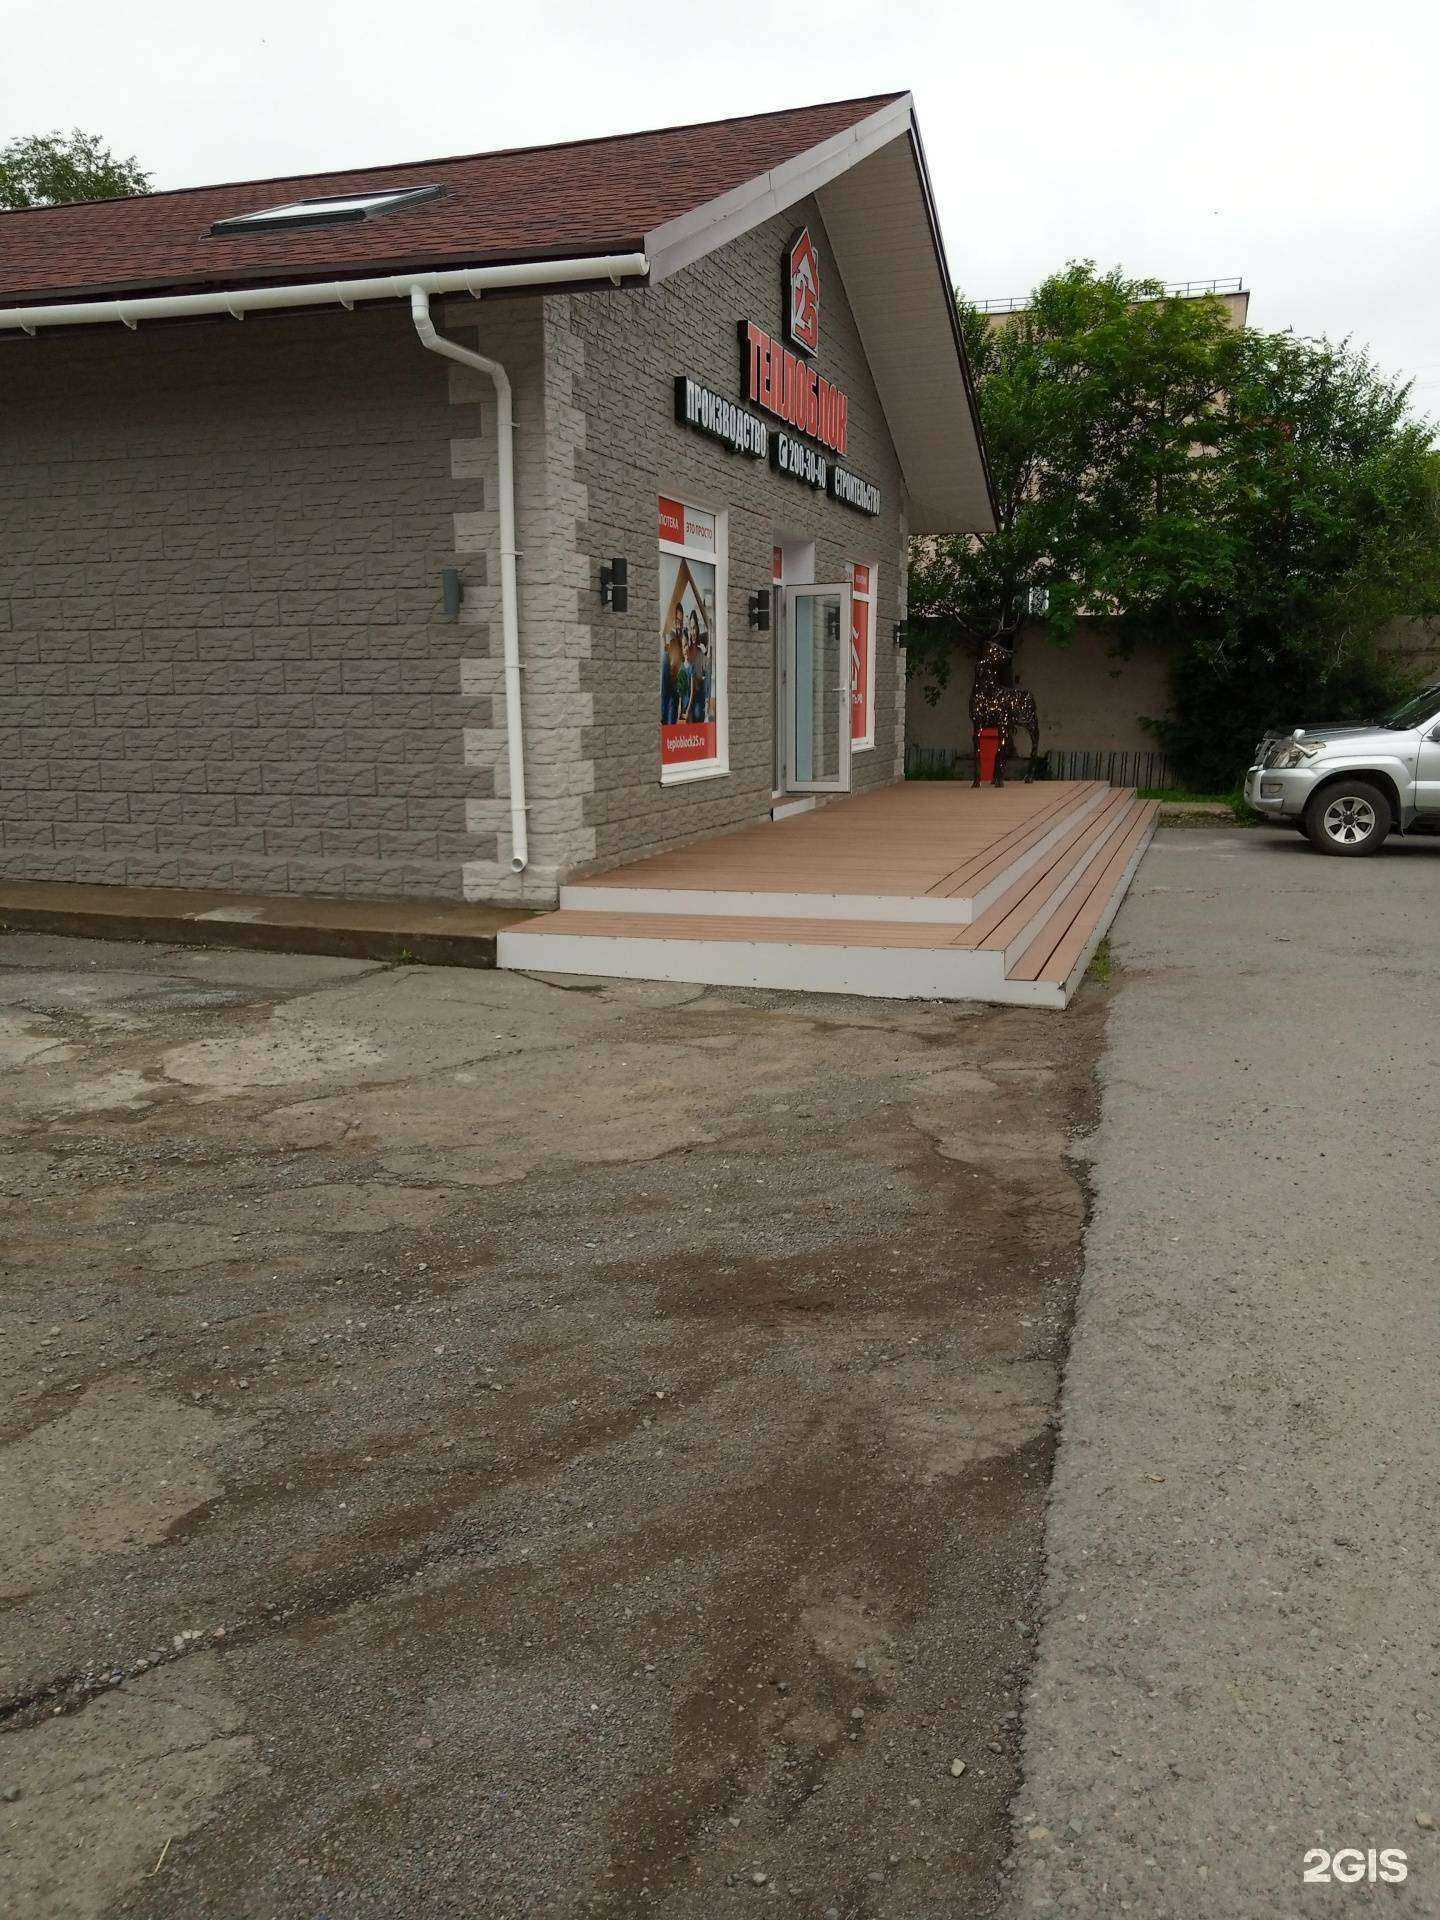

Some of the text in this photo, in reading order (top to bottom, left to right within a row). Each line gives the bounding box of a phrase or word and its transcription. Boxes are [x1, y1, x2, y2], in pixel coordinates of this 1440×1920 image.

[686, 379, 767, 458] ПРОИЗВОДСТВО
[747, 320, 848, 455] ТЕПЛОБЛОК
[788, 439, 827, 489] 200-30-40
[834, 465, 881, 516] СТРОИТЕЛЬСТВО
